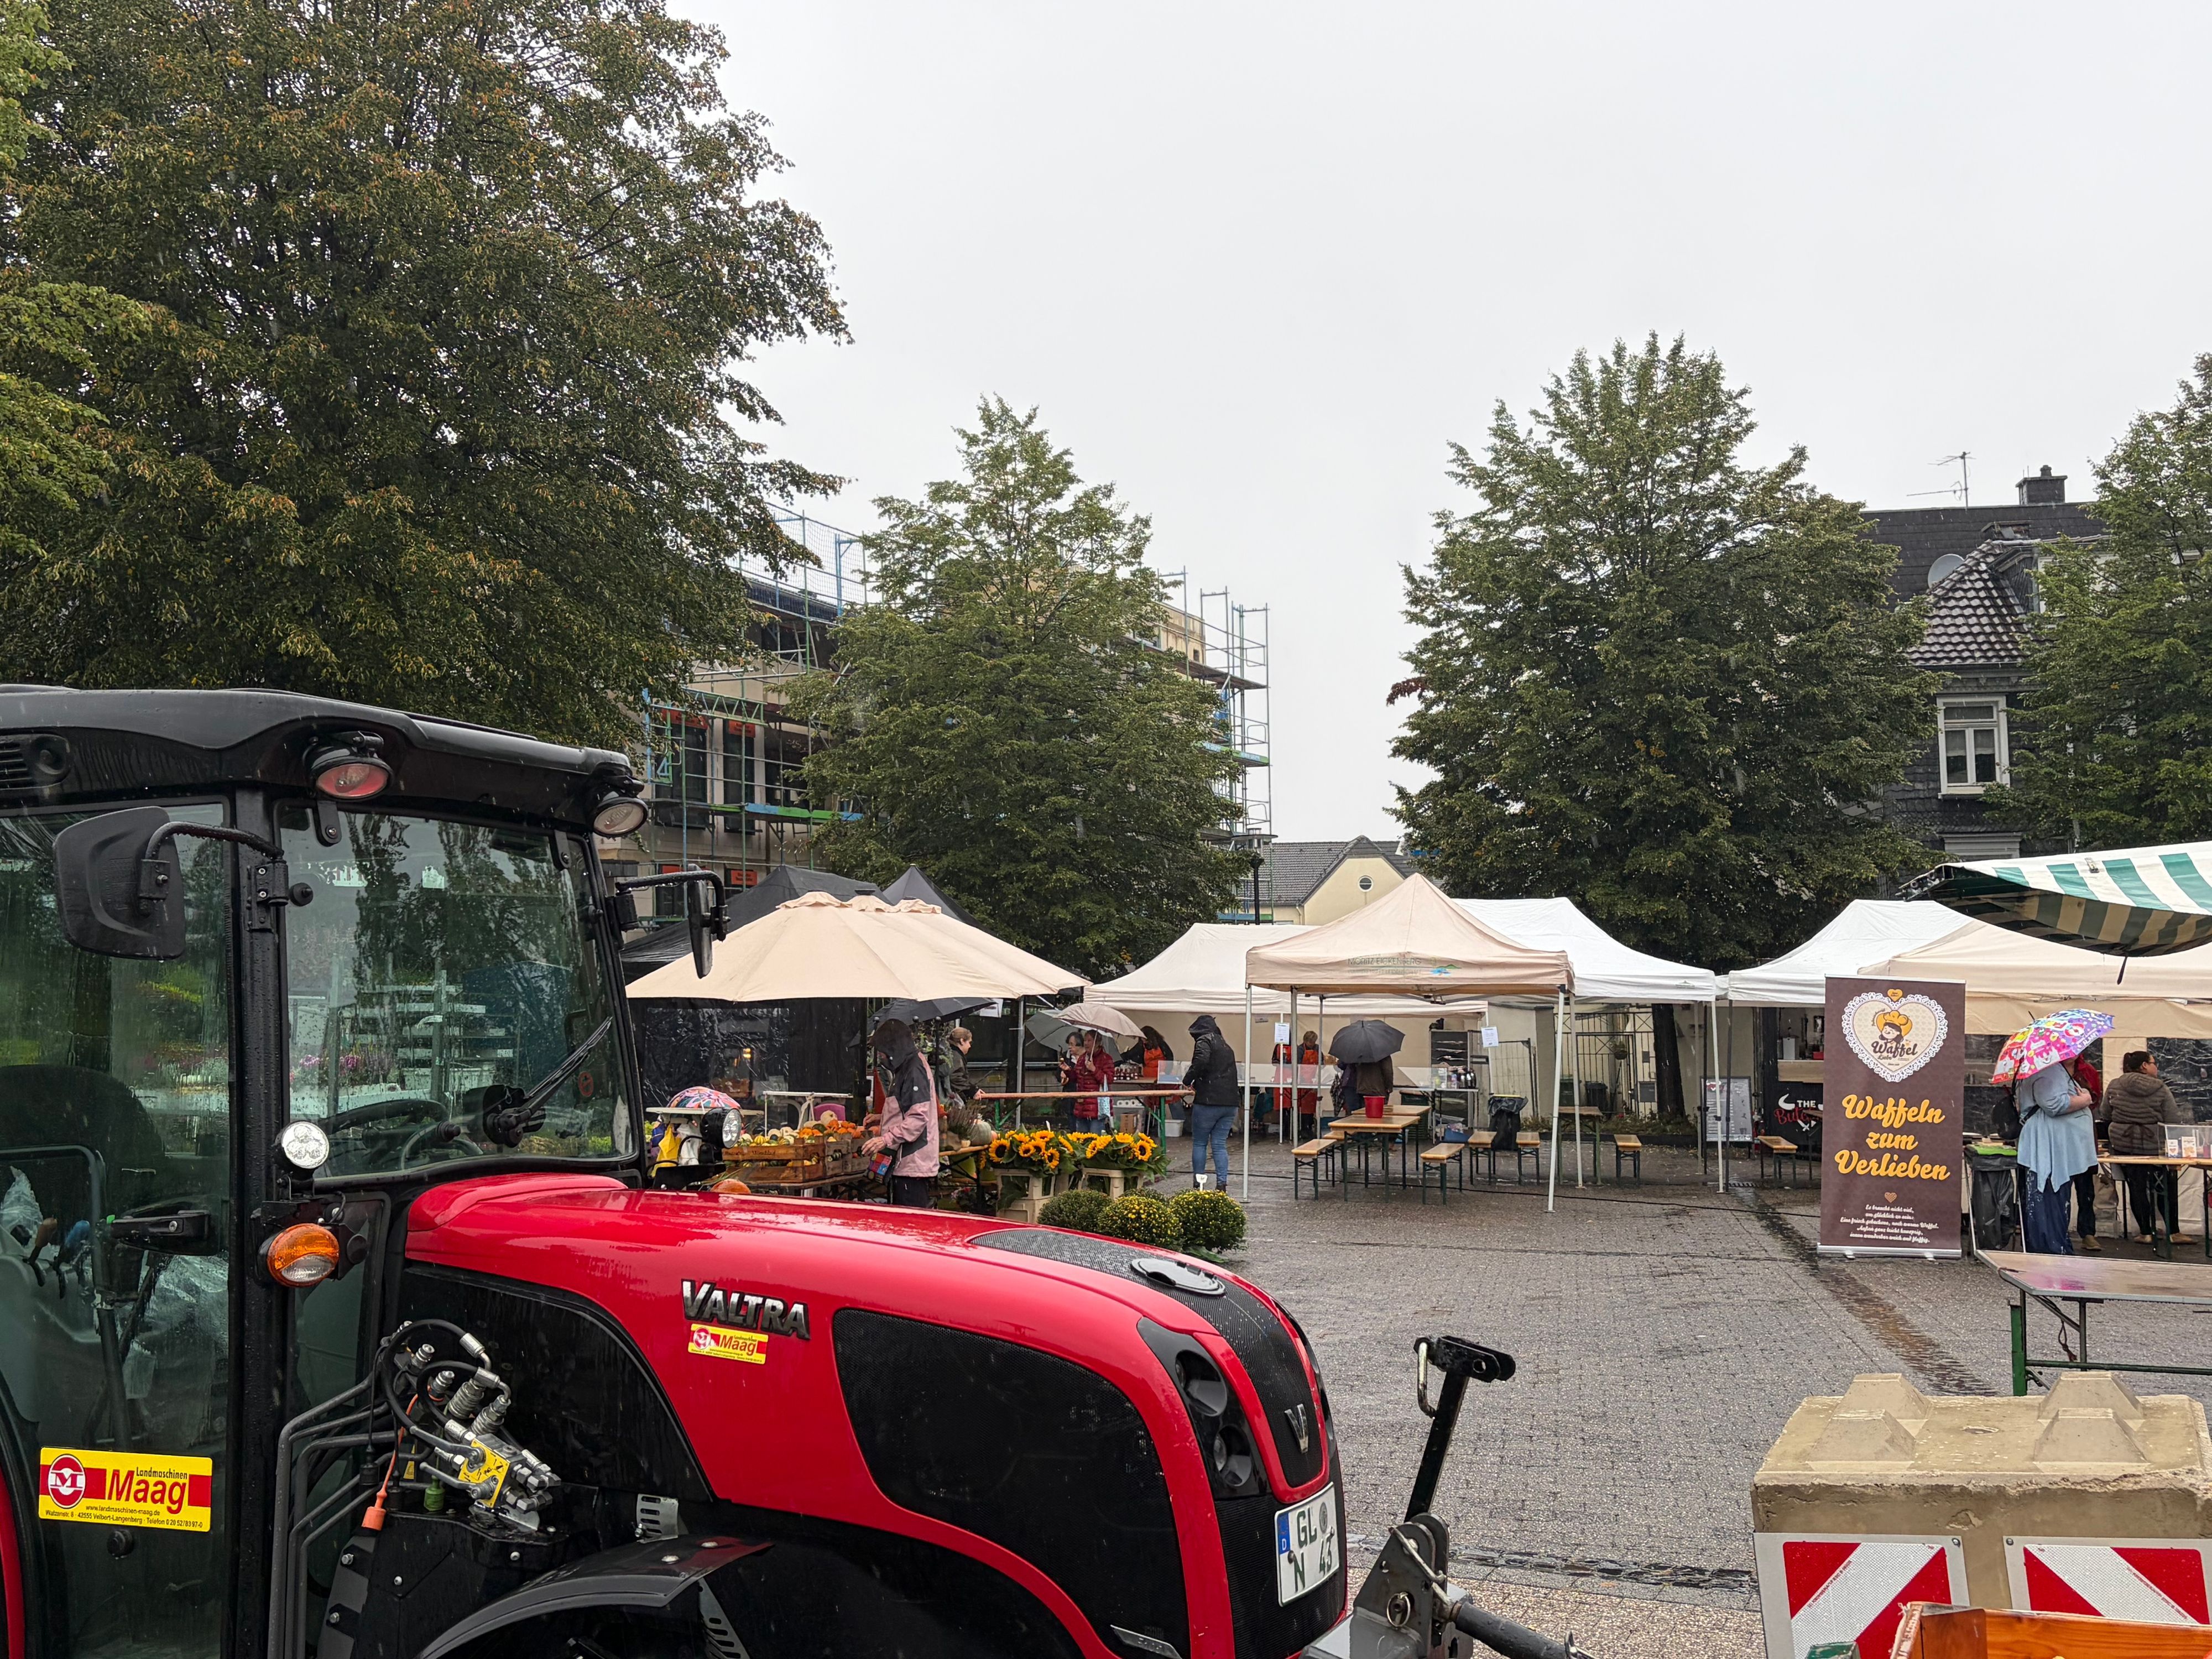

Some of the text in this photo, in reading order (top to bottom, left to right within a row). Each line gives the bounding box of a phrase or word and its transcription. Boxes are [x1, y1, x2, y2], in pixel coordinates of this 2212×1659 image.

[1871, 1041, 1918, 1058] Waffel
[1797, 1100, 1816, 1108] THE
[1841, 1094, 1945, 1129] Waffeln
[1865, 1131, 1918, 1150] zum
[1834, 1149, 1951, 1181] Verlieben
[681, 1279, 810, 1339] VALTRA
[720, 1335, 757, 1356] Maag
[52, 1472, 81, 1489] M
[136, 1466, 188, 1480] Landmaschinen
[107, 1469, 187, 1515] Maag
[1296, 1506, 1318, 1549] GL
[1281, 1538, 1287, 1551] D
[1293, 1551, 1306, 1593] N
